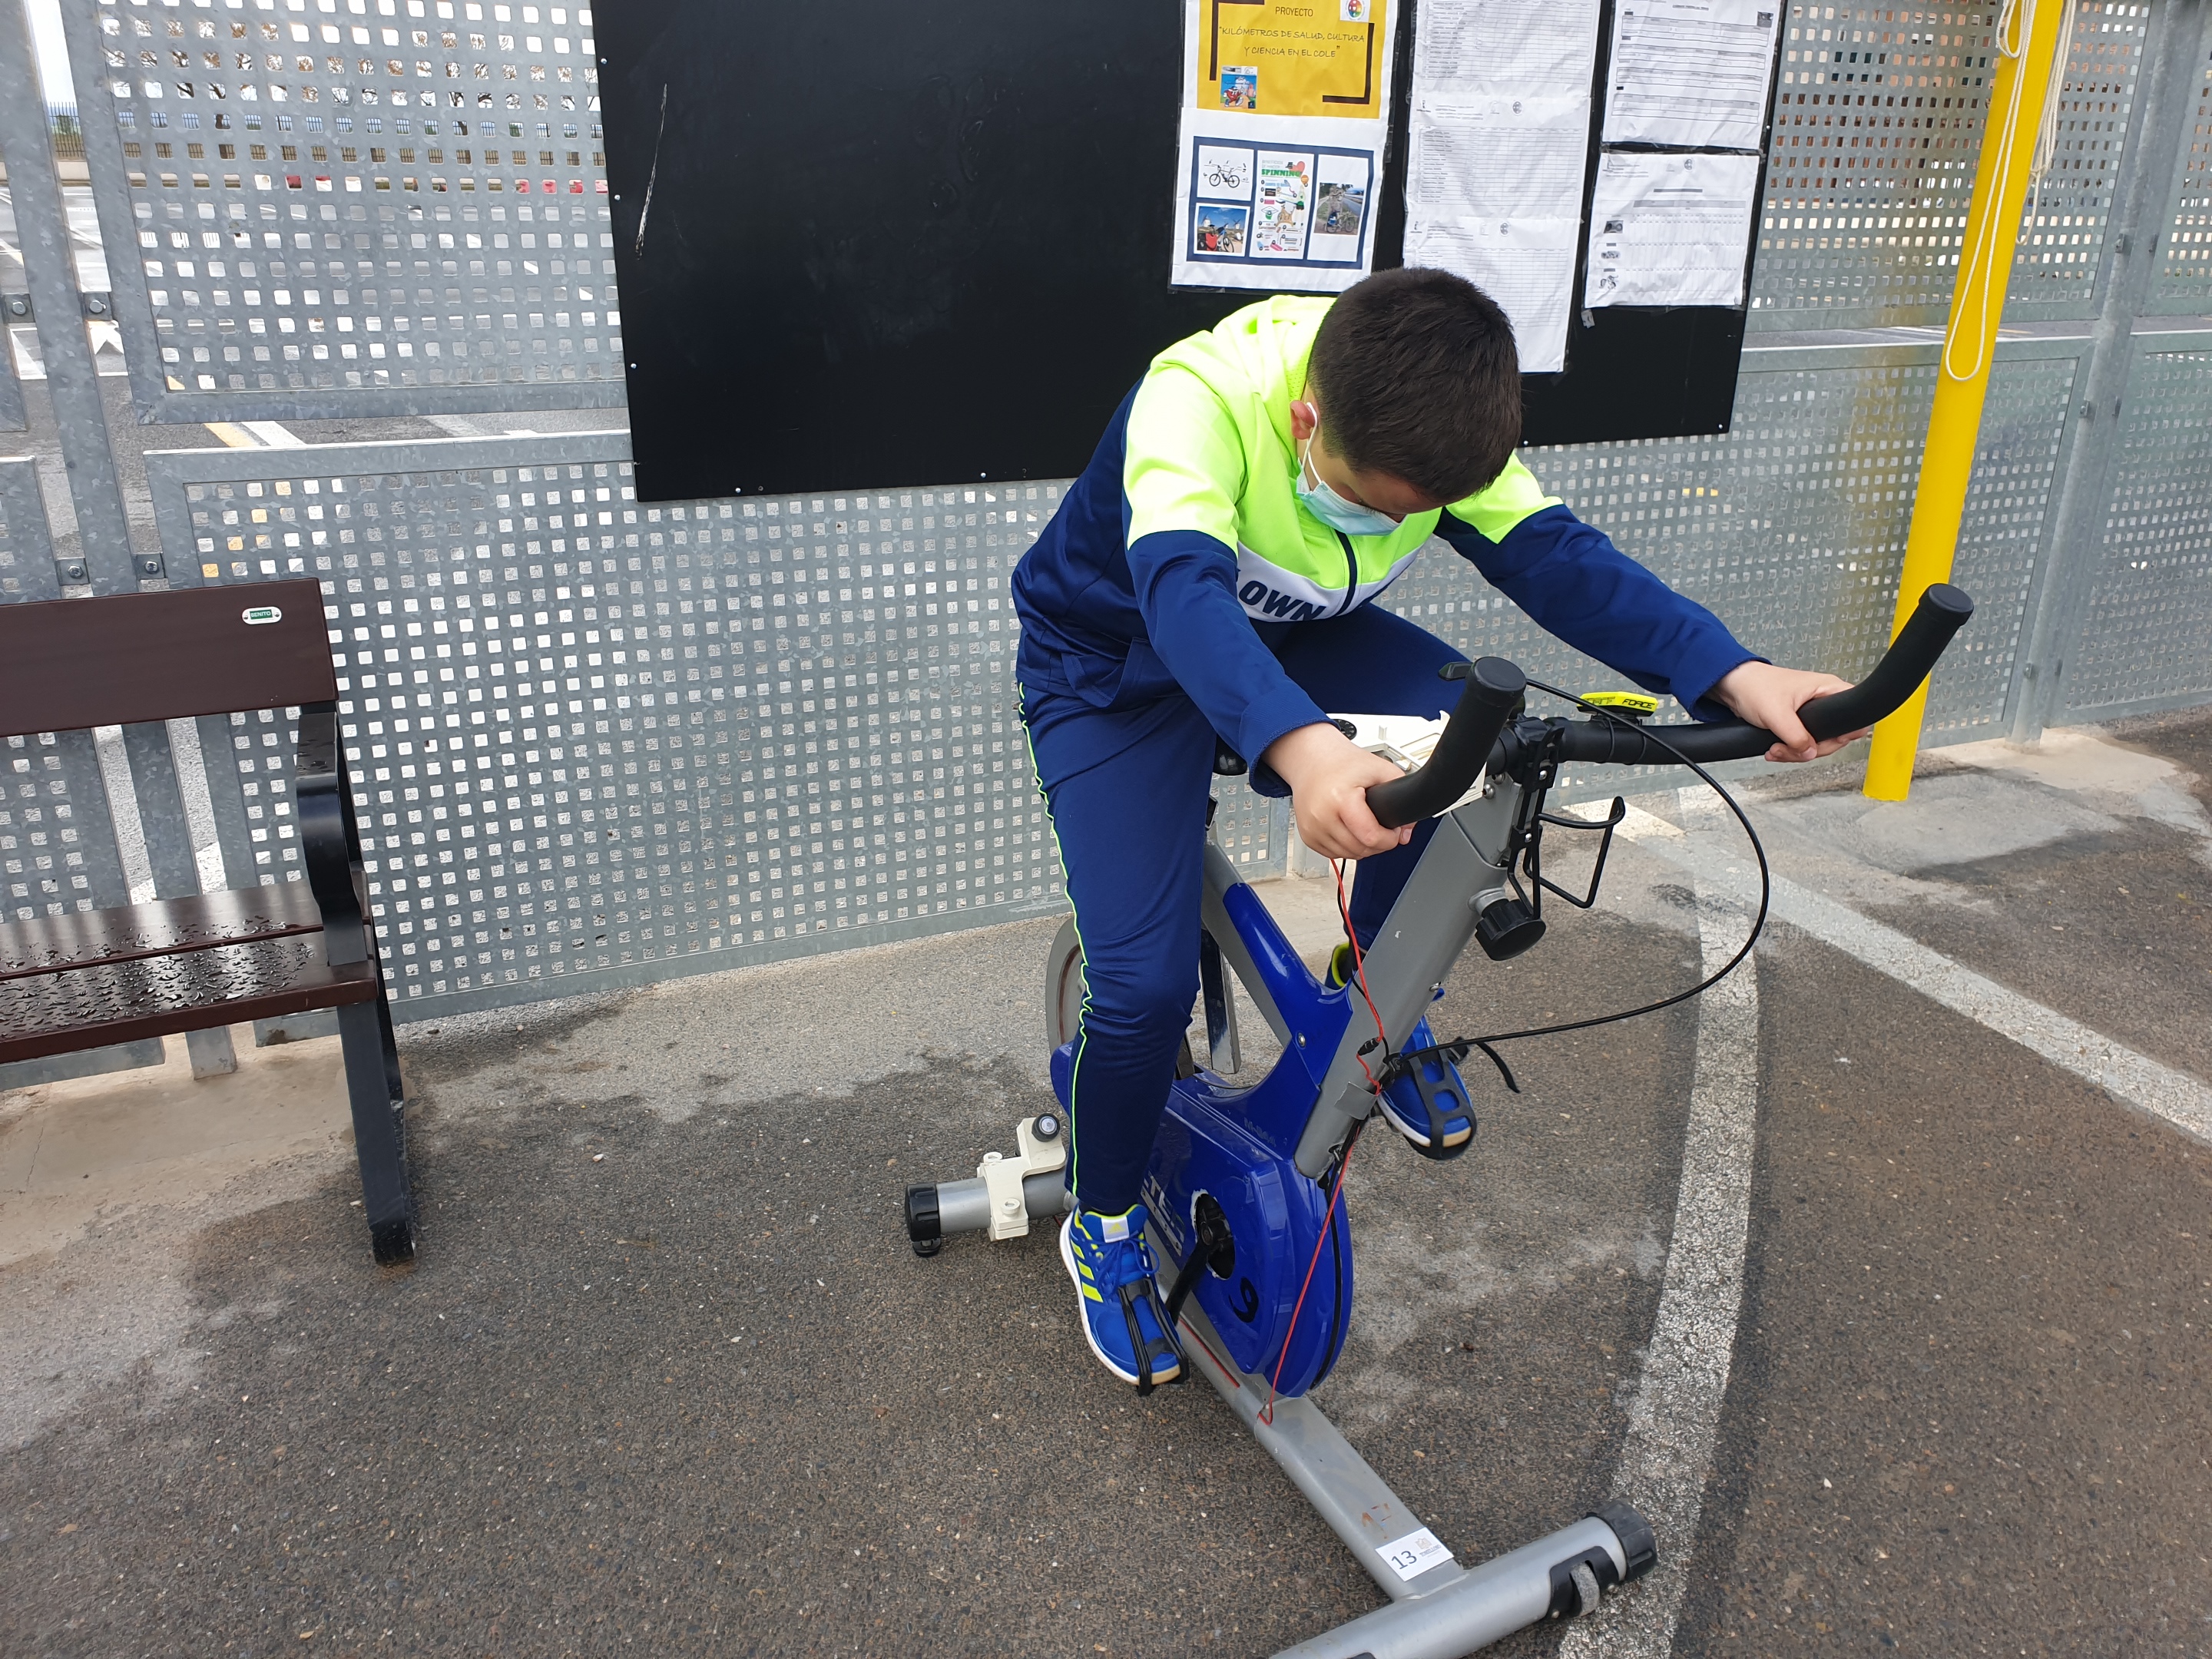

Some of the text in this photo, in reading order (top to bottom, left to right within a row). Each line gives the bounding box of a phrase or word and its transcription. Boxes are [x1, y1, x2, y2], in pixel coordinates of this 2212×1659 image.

[1275, 6, 1313, 17] PROYECTO
[1293, 31, 1325, 41] SALUD,
[1326, 33, 1365, 42] CULTURA
[1243, 46, 1250, 56] Y
[1251, 47, 1286, 56] CIENCIA
[1262, 168, 1301, 177] SPINNING
[1237, 569, 1327, 621] OWN
[1622, 699, 1655, 709] FORCE
[1391, 1550, 1418, 1570] 13
